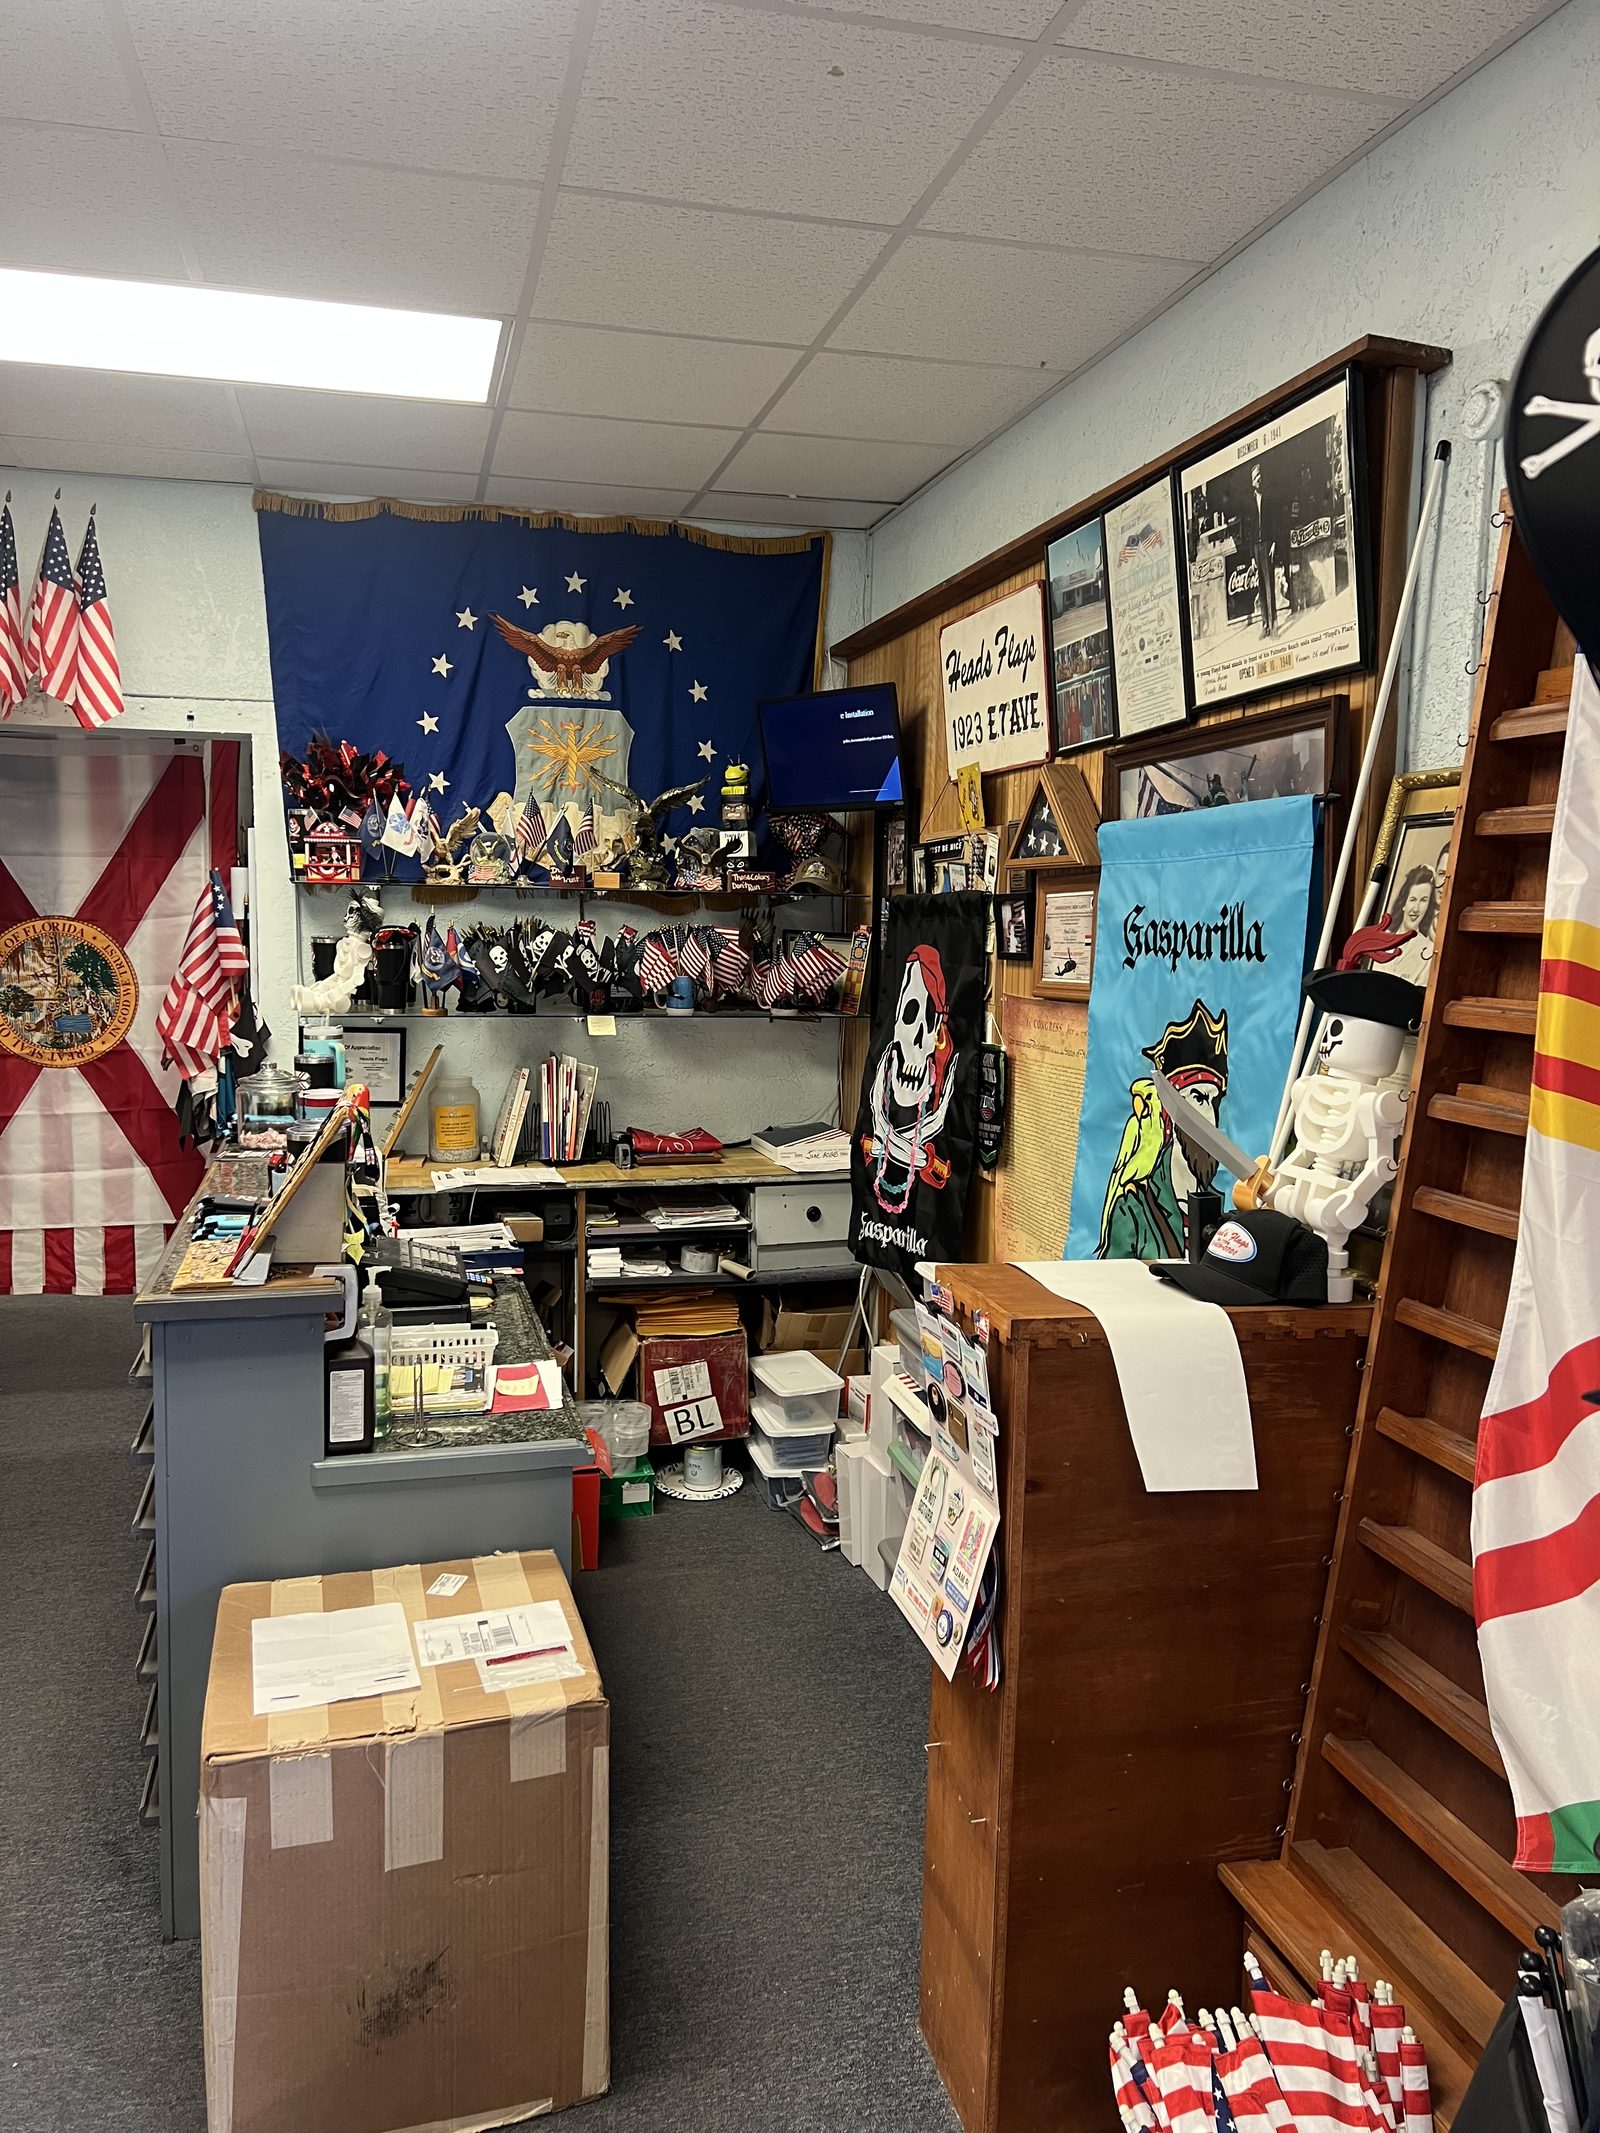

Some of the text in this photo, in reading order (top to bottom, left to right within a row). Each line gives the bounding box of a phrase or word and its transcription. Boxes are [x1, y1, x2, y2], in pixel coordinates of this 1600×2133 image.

[946, 625, 1037, 693] Heads Flags
[952, 711, 984, 751] 1923
[942, 844, 949, 852] BE
[949, 841, 963, 851] NICE
[3, 921, 86, 949] OF FLORIDA
[1122, 902, 1268, 973] Gasparilla
[101, 944, 132, 1038] IN GOD WE TRUST
[10, 1036, 45, 1060] SEAL
[47, 1045, 95, 1063] GREAT
[858, 1211, 929, 1257] Gasparilla
[1230, 1232, 1250, 1248] Flags
[673, 1404, 715, 1436] BL
[952, 1564, 966, 1581] ADAM
